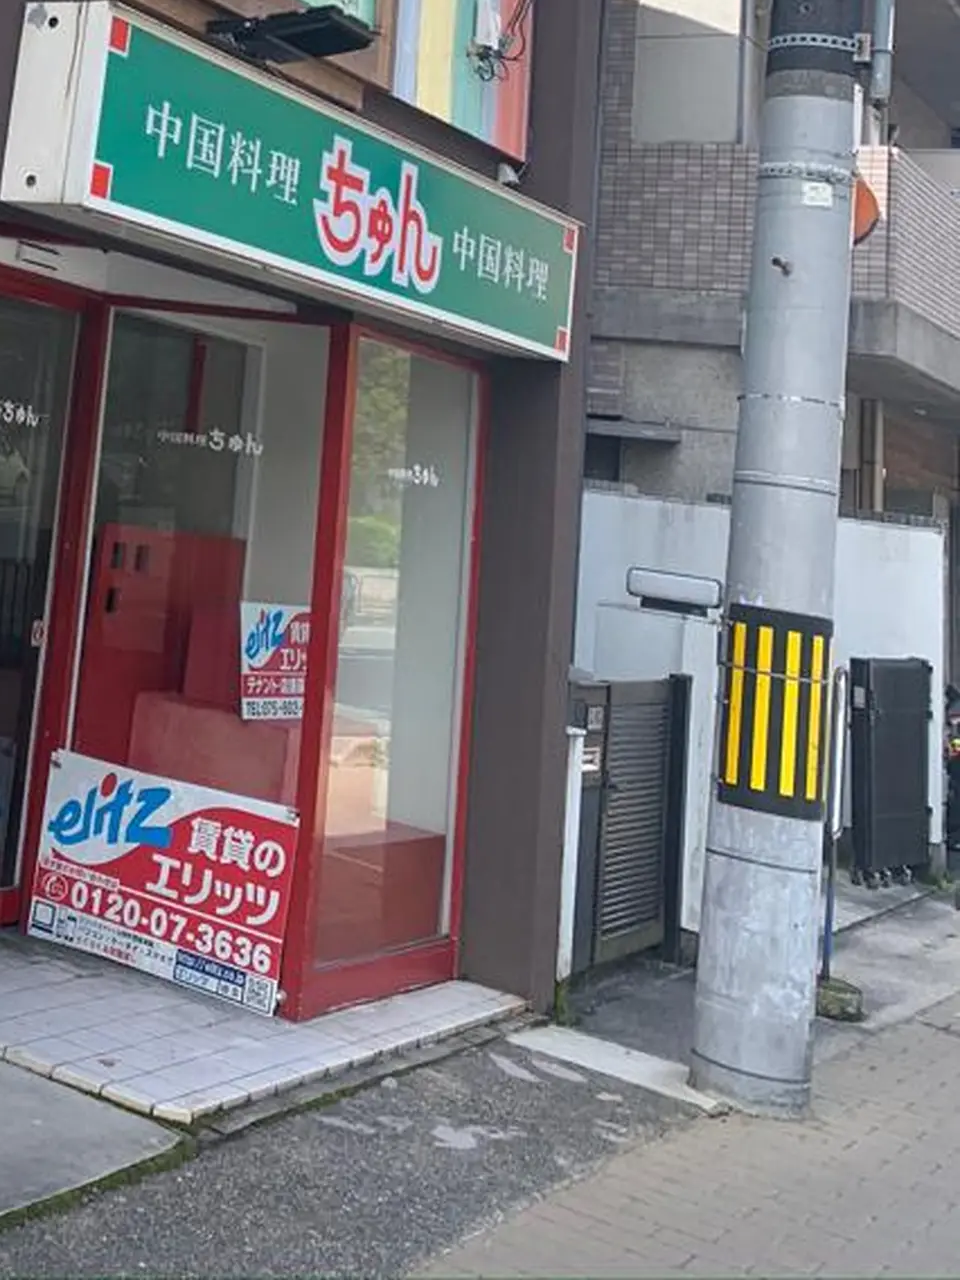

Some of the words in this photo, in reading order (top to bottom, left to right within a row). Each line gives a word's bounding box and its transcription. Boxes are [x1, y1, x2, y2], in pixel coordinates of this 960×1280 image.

[145, 100, 300, 207] 中国料理
[314, 136, 442, 293] ちゅん
[451, 226, 549, 303] 中国料理
[207, 427, 264, 457] ちゅん
[48, 772, 173, 849] elitz
[189, 816, 287, 879] 賃貸の
[145, 851, 280, 927] エリッツ
[71, 880, 274, 975] 0120-07-3636
